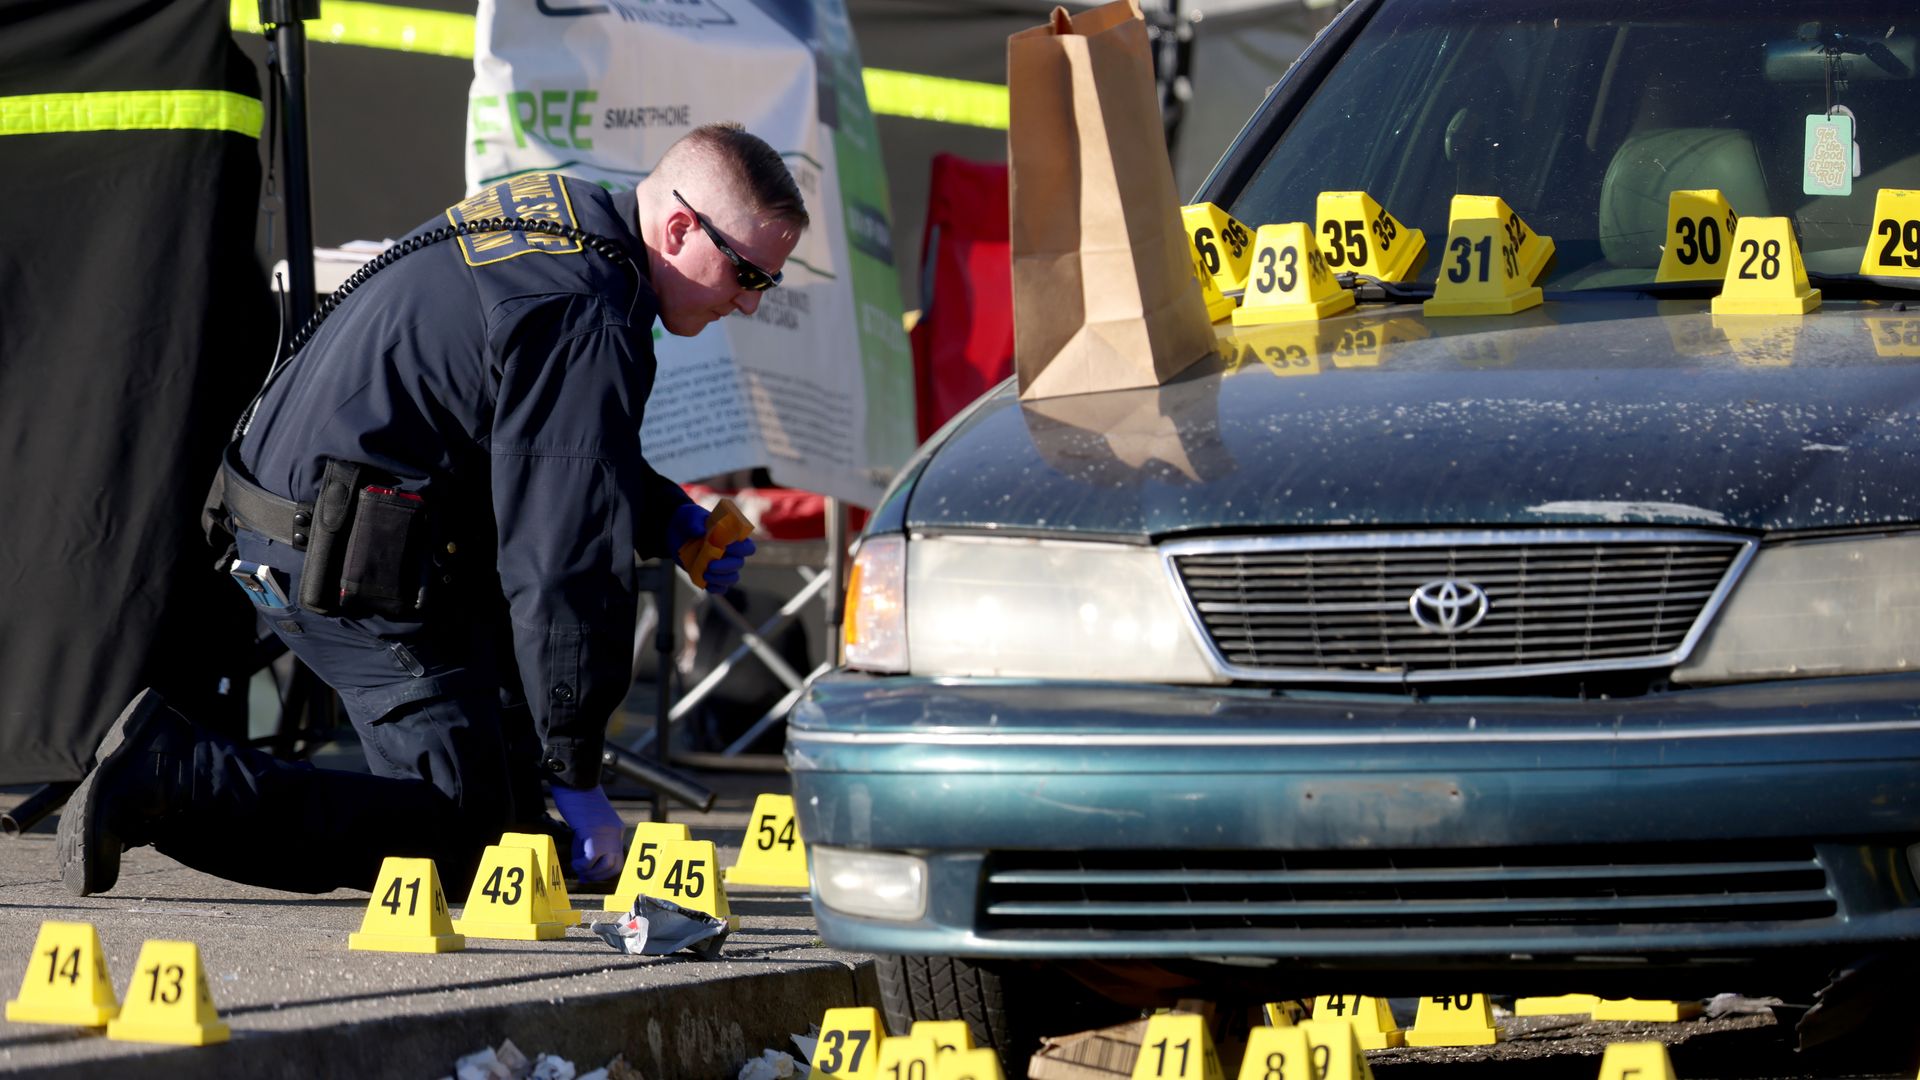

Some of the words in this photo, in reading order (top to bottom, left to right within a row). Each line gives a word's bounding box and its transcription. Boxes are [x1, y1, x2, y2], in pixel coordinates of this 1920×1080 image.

[472, 90, 598, 154] FREE
[1817, 128, 1835, 143] Let
[1809, 159, 1845, 172] Times
[1815, 145, 1844, 160] Good
[1826, 141, 1840, 151] the
[1817, 170, 1842, 185] Roll
[1222, 218, 1249, 259] 36
[1322, 219, 1369, 268] 35
[1372, 209, 1397, 251] 35
[1675, 216, 1721, 265] 30
[1878, 219, 1920, 267] 29
[1195, 227, 1220, 275] 6
[1256, 246, 1298, 293] 33
[1308, 249, 1327, 286] 33
[1447, 236, 1492, 284] 31
[1503, 244, 1519, 279] 31
[1739, 239, 1780, 280] 28
[757, 814, 795, 851] 54
[551, 865, 561, 891] 44
[637, 842, 659, 881] 5
[663, 859, 705, 898] 45
[381, 877, 420, 916] 41
[436, 888, 445, 915] 41
[482, 866, 525, 905] 43
[44, 946, 81, 984] 14
[145, 964, 184, 1004] 13
[819, 1030, 871, 1073] 37
[1151, 1038, 1190, 1077] 11
[1264, 1053, 1285, 1080] 8
[1311, 1045, 1330, 1080] 9
